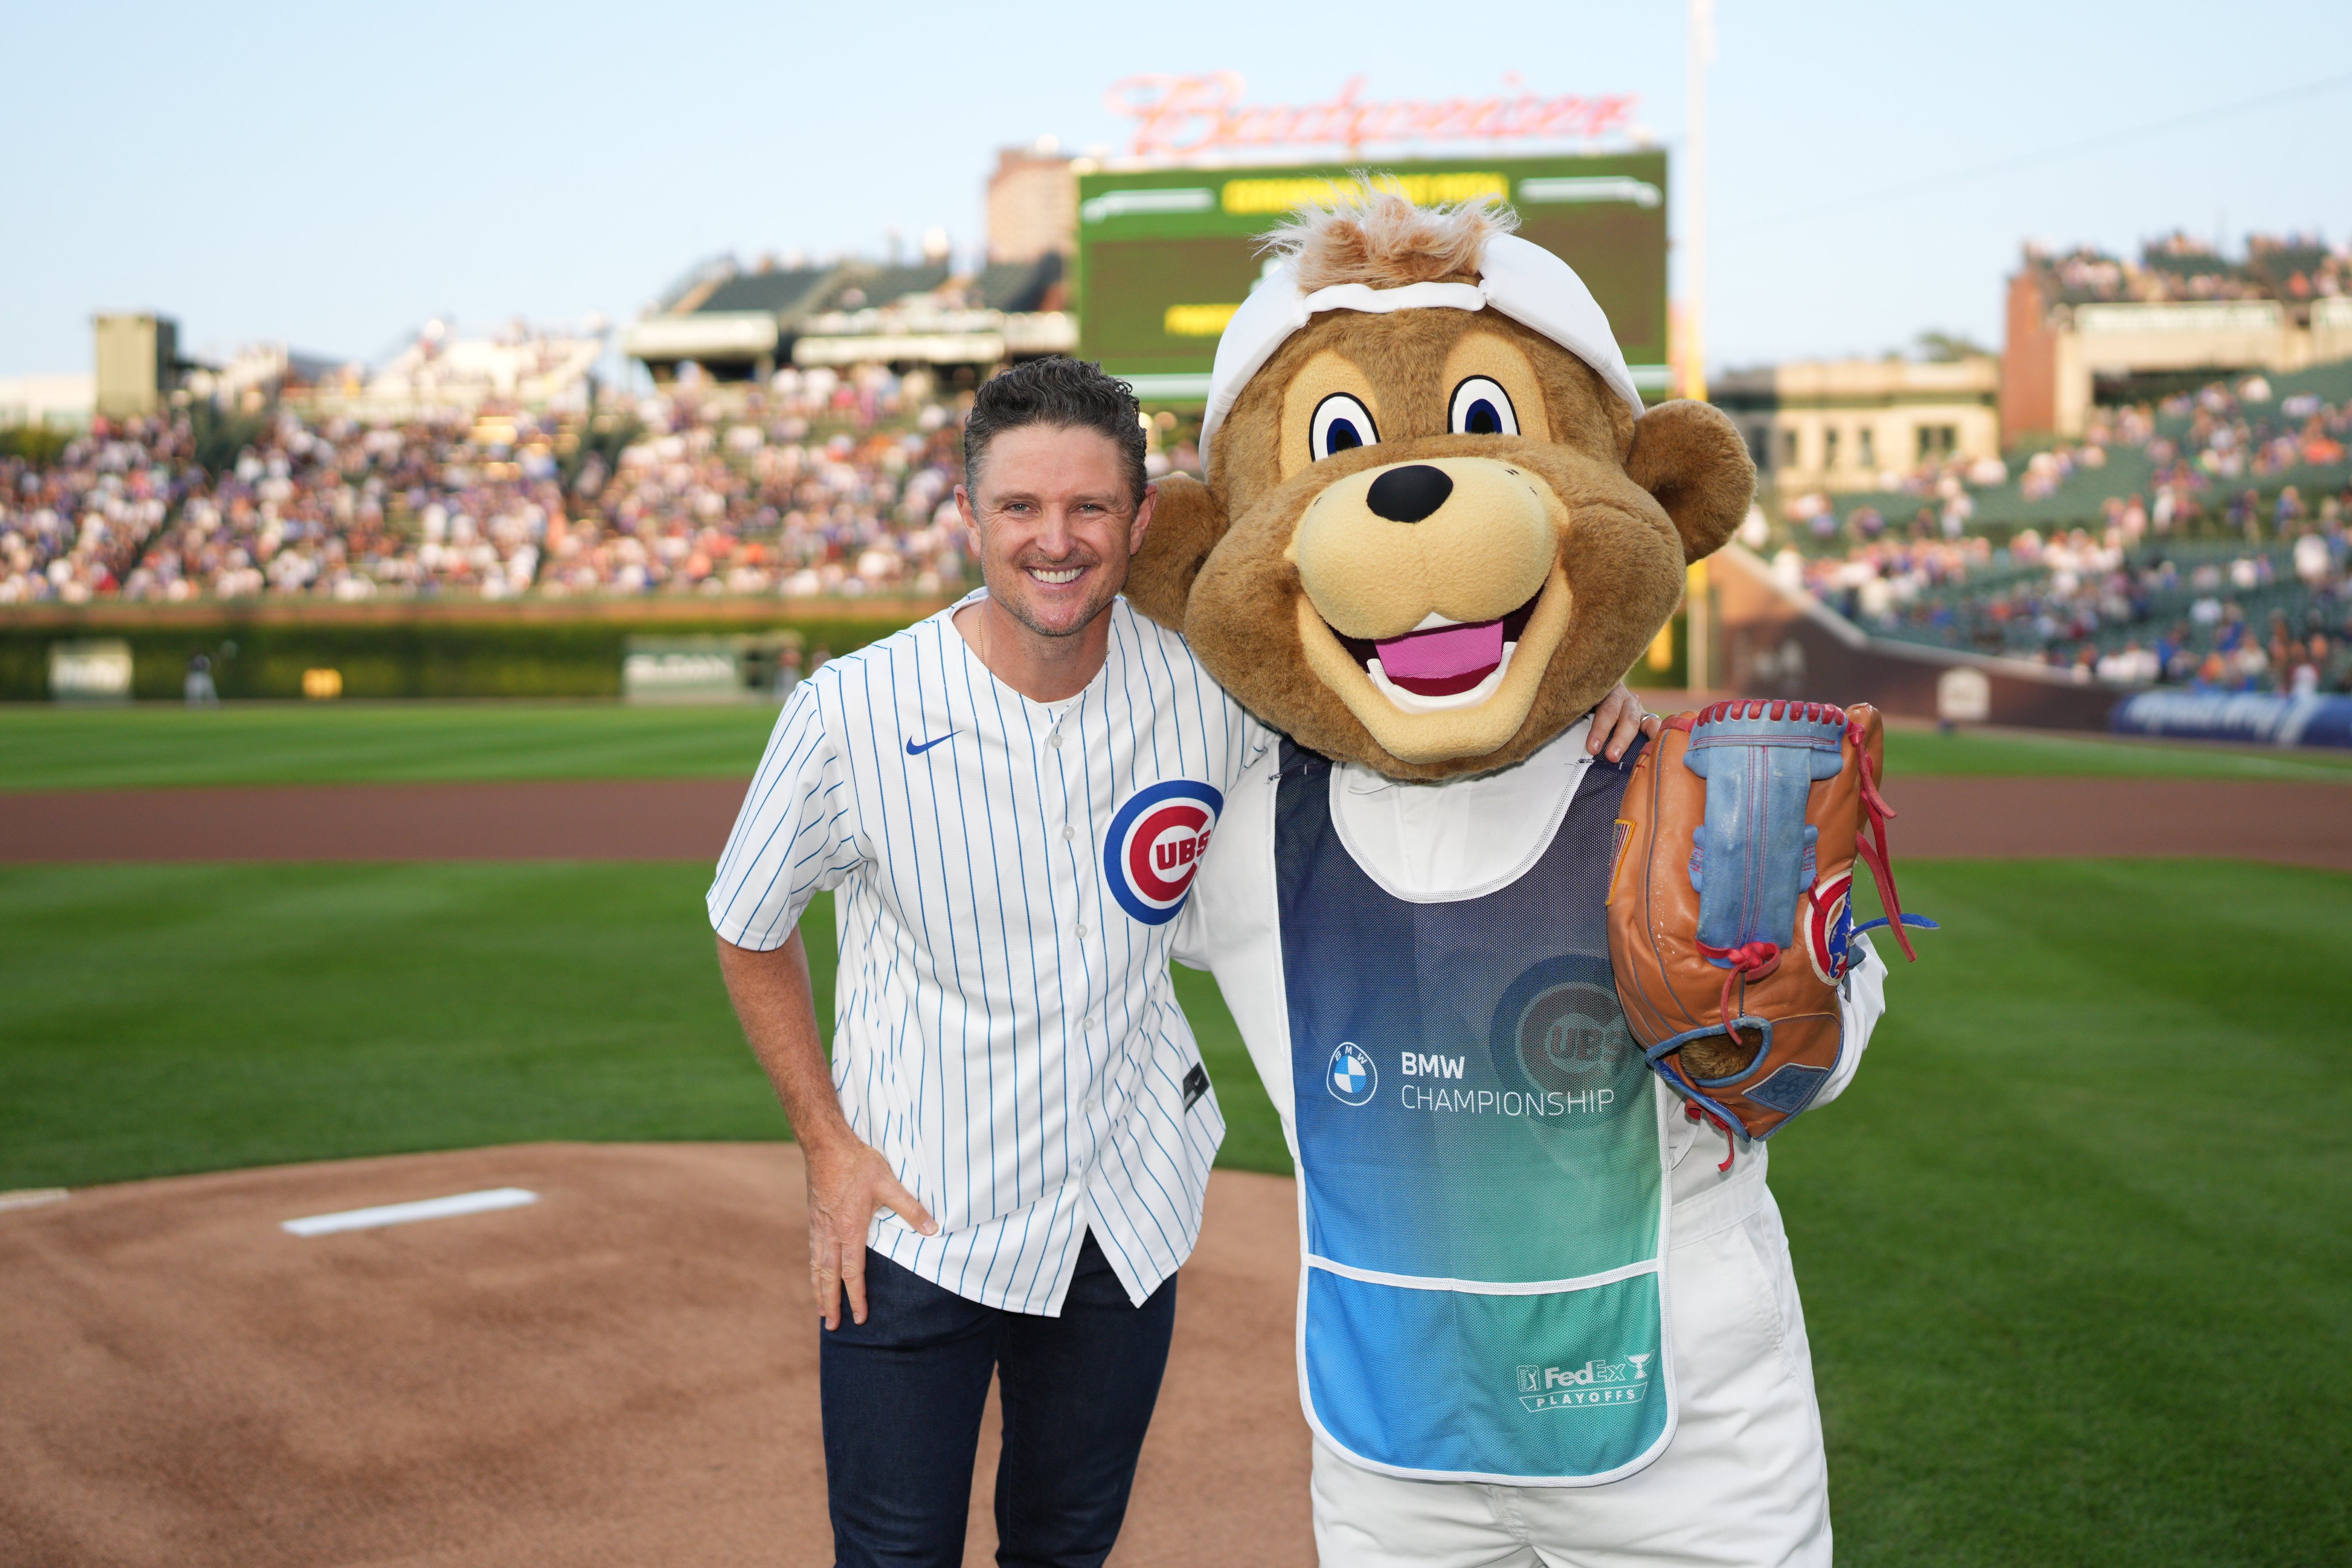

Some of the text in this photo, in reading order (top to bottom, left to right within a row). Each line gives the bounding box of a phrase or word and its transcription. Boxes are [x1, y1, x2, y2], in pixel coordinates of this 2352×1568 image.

[1335, 1045, 1367, 1065] BMW
[1401, 1051, 1465, 1079] BMW
[1401, 1085, 1615, 1117] CHAMPIONSHIP
[1544, 1359, 1626, 1389] FedEx
[1536, 1389, 1636, 1408] PLAYOFFS
